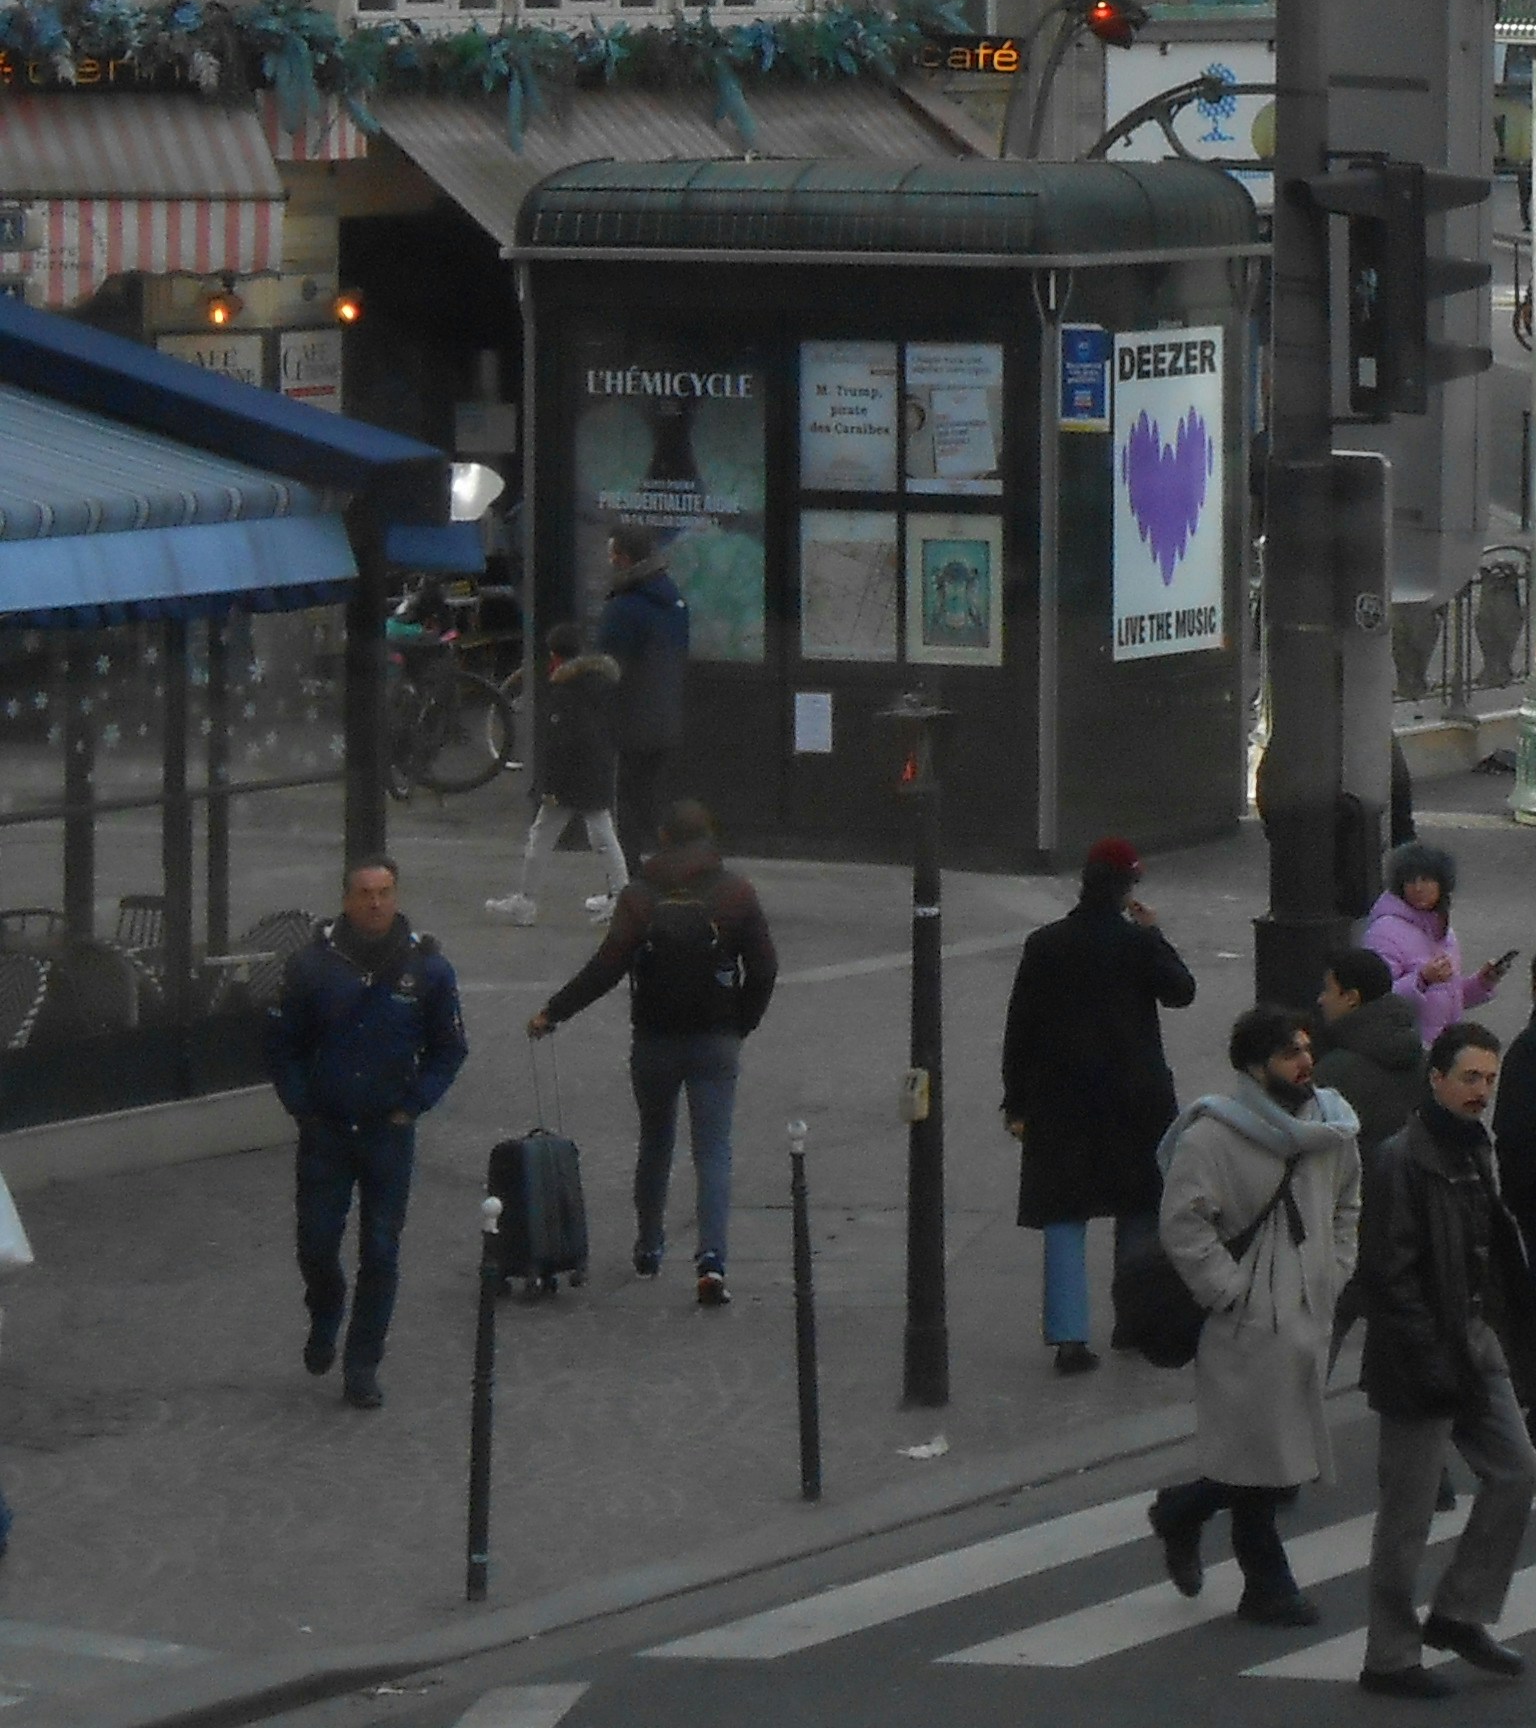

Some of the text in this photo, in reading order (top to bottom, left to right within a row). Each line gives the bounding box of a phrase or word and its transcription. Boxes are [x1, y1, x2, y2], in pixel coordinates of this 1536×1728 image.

[1118, 339, 1216, 382] DEEZER
[587, 365, 753, 398] L'HÉMICYCLE
[837, 384, 883, 399] Trump,
[810, 422, 831, 433] des
[1118, 606, 1216, 647] LIVE THE MUSIC
